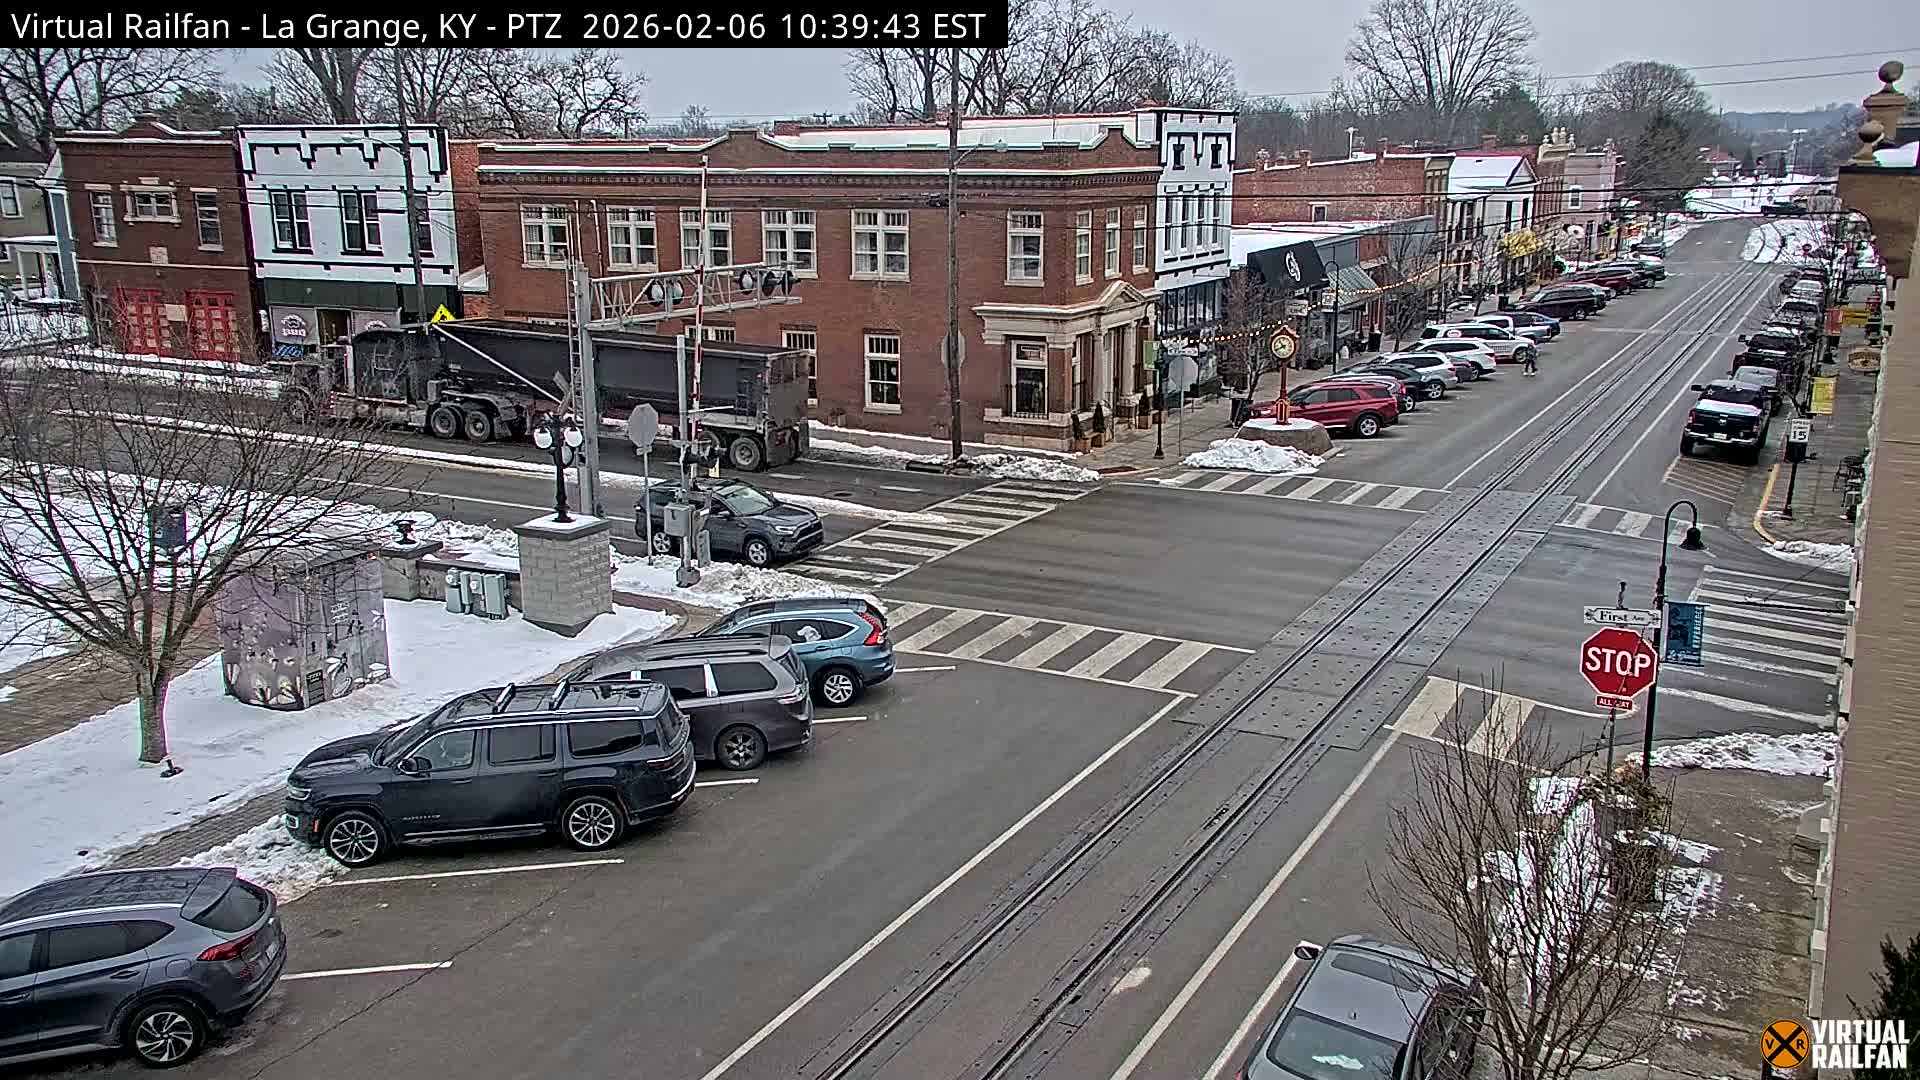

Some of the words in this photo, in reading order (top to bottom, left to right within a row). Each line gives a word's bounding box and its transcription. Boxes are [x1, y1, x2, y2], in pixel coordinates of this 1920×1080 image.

[1793, 431, 1806, 440] 15
[1600, 611, 1628, 621] First
[1585, 647, 1651, 677] STOP
[1599, 698, 1612, 706] ALL
